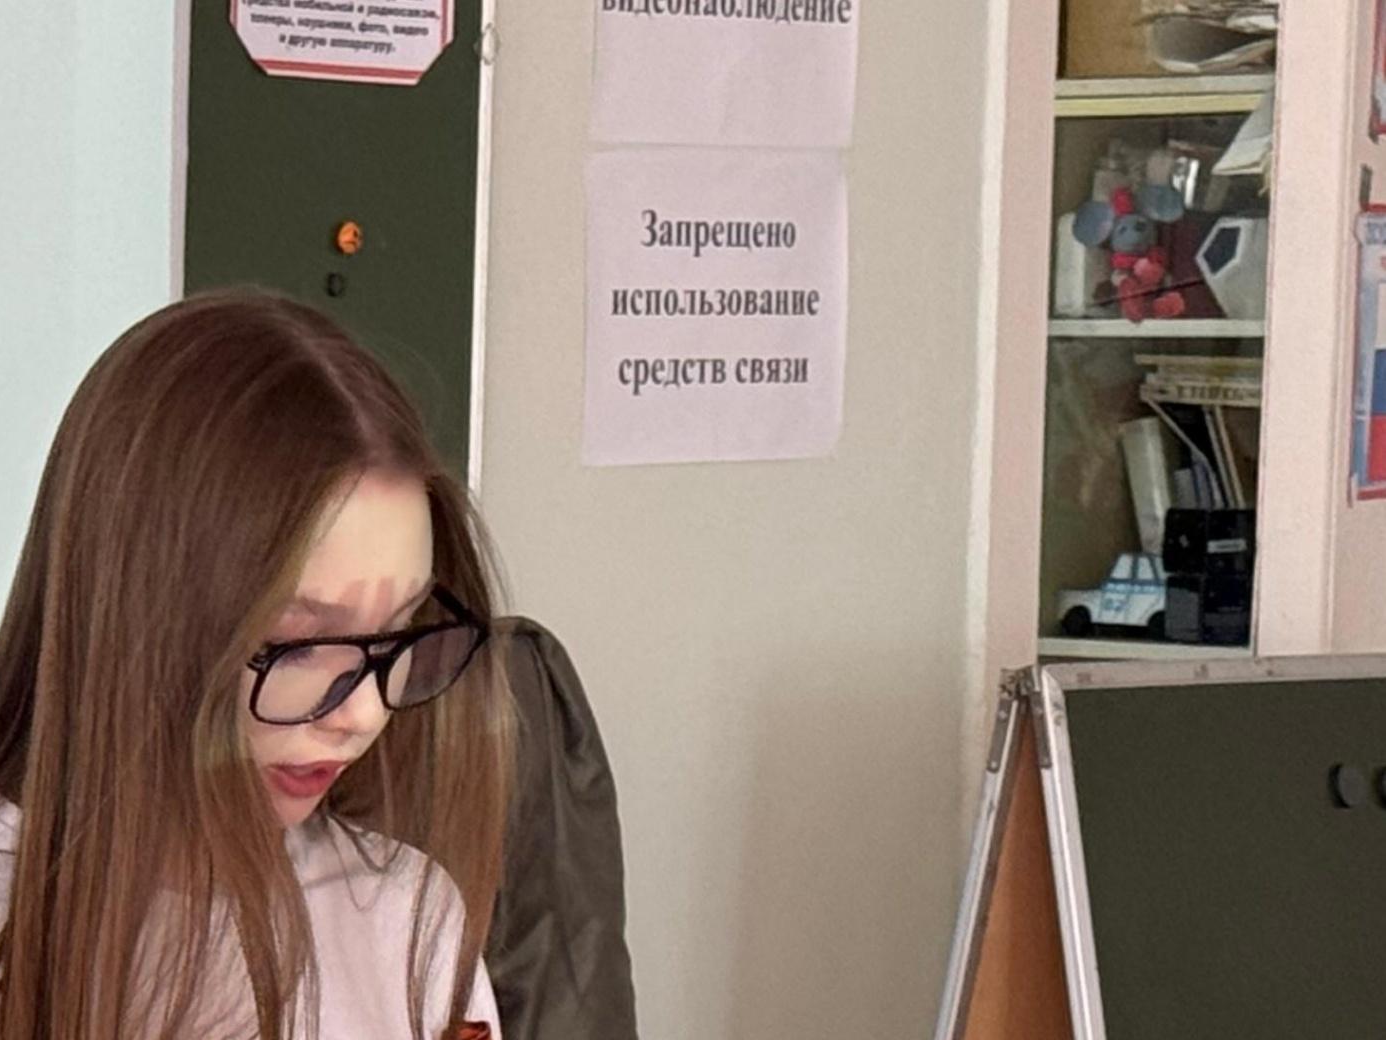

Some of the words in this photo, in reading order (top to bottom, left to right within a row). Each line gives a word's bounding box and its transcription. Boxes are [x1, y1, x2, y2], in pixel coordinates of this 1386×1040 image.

[357, 5, 364, 13] и
[298, 17, 355, 32] наушники,
[358, 20, 390, 36] фото,
[393, 24, 430, 37] видео
[279, 34, 286, 43] и
[288, 34, 327, 49] другую
[640, 208, 797, 257] Запрещено
[611, 287, 821, 317] использование
[618, 356, 727, 396] средств
[735, 355, 810, 384] связи
